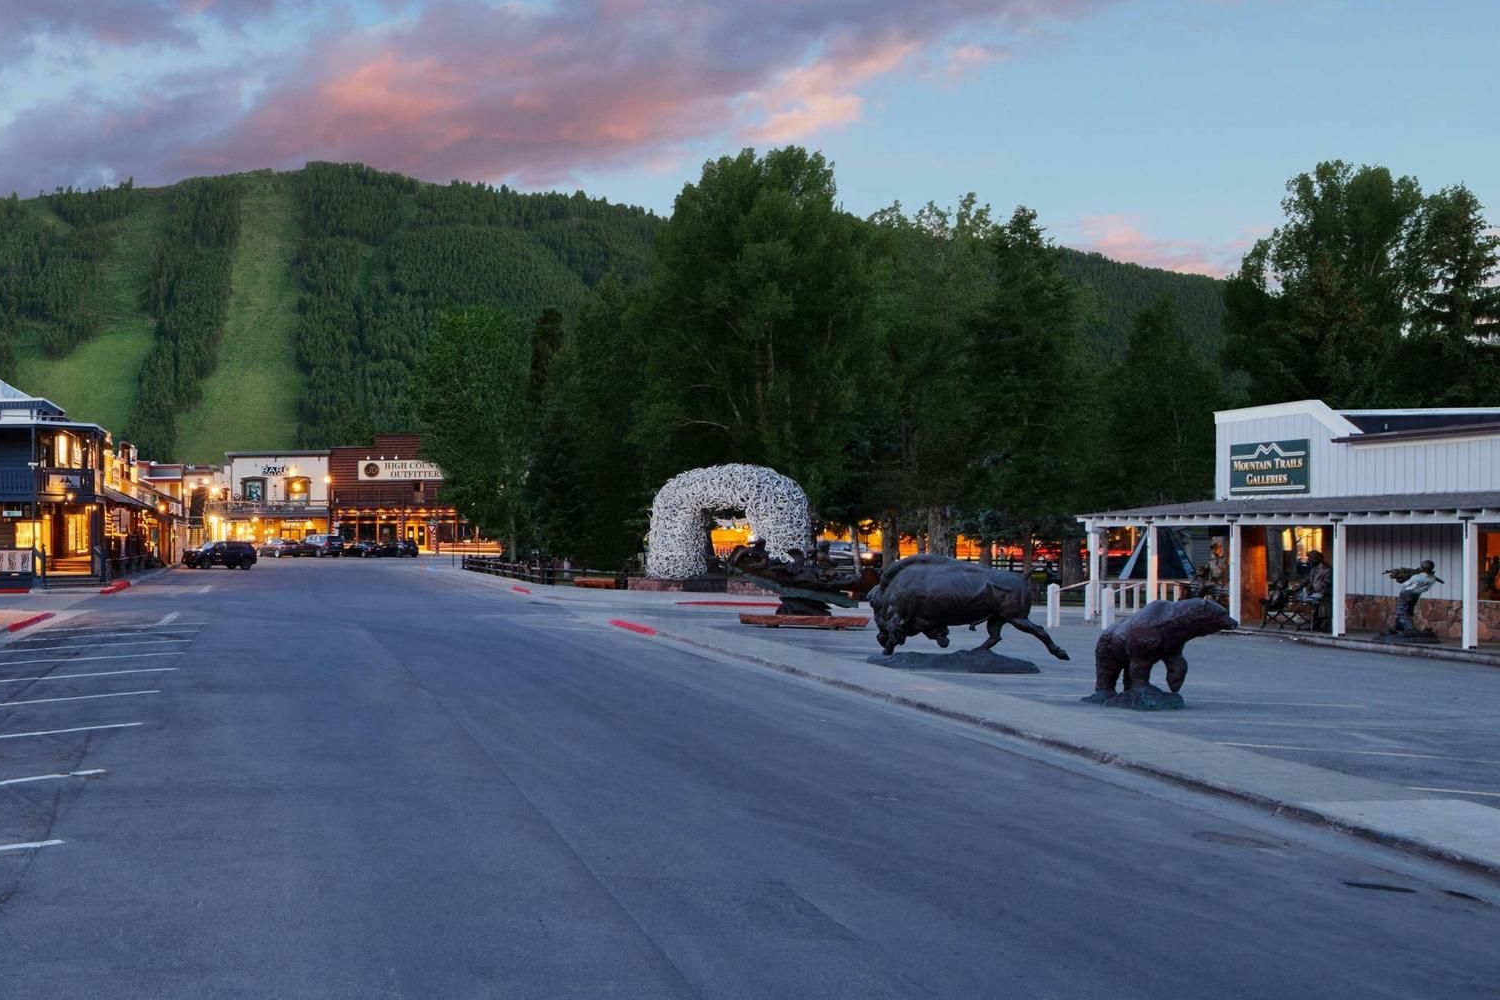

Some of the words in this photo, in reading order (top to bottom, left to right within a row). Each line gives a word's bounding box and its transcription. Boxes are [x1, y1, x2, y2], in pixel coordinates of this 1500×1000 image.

[1233, 460, 1272, 471] MOUNTAIN
[1273, 457, 1303, 469] TRAILS
[1246, 473, 1288, 485] GALLERIES
